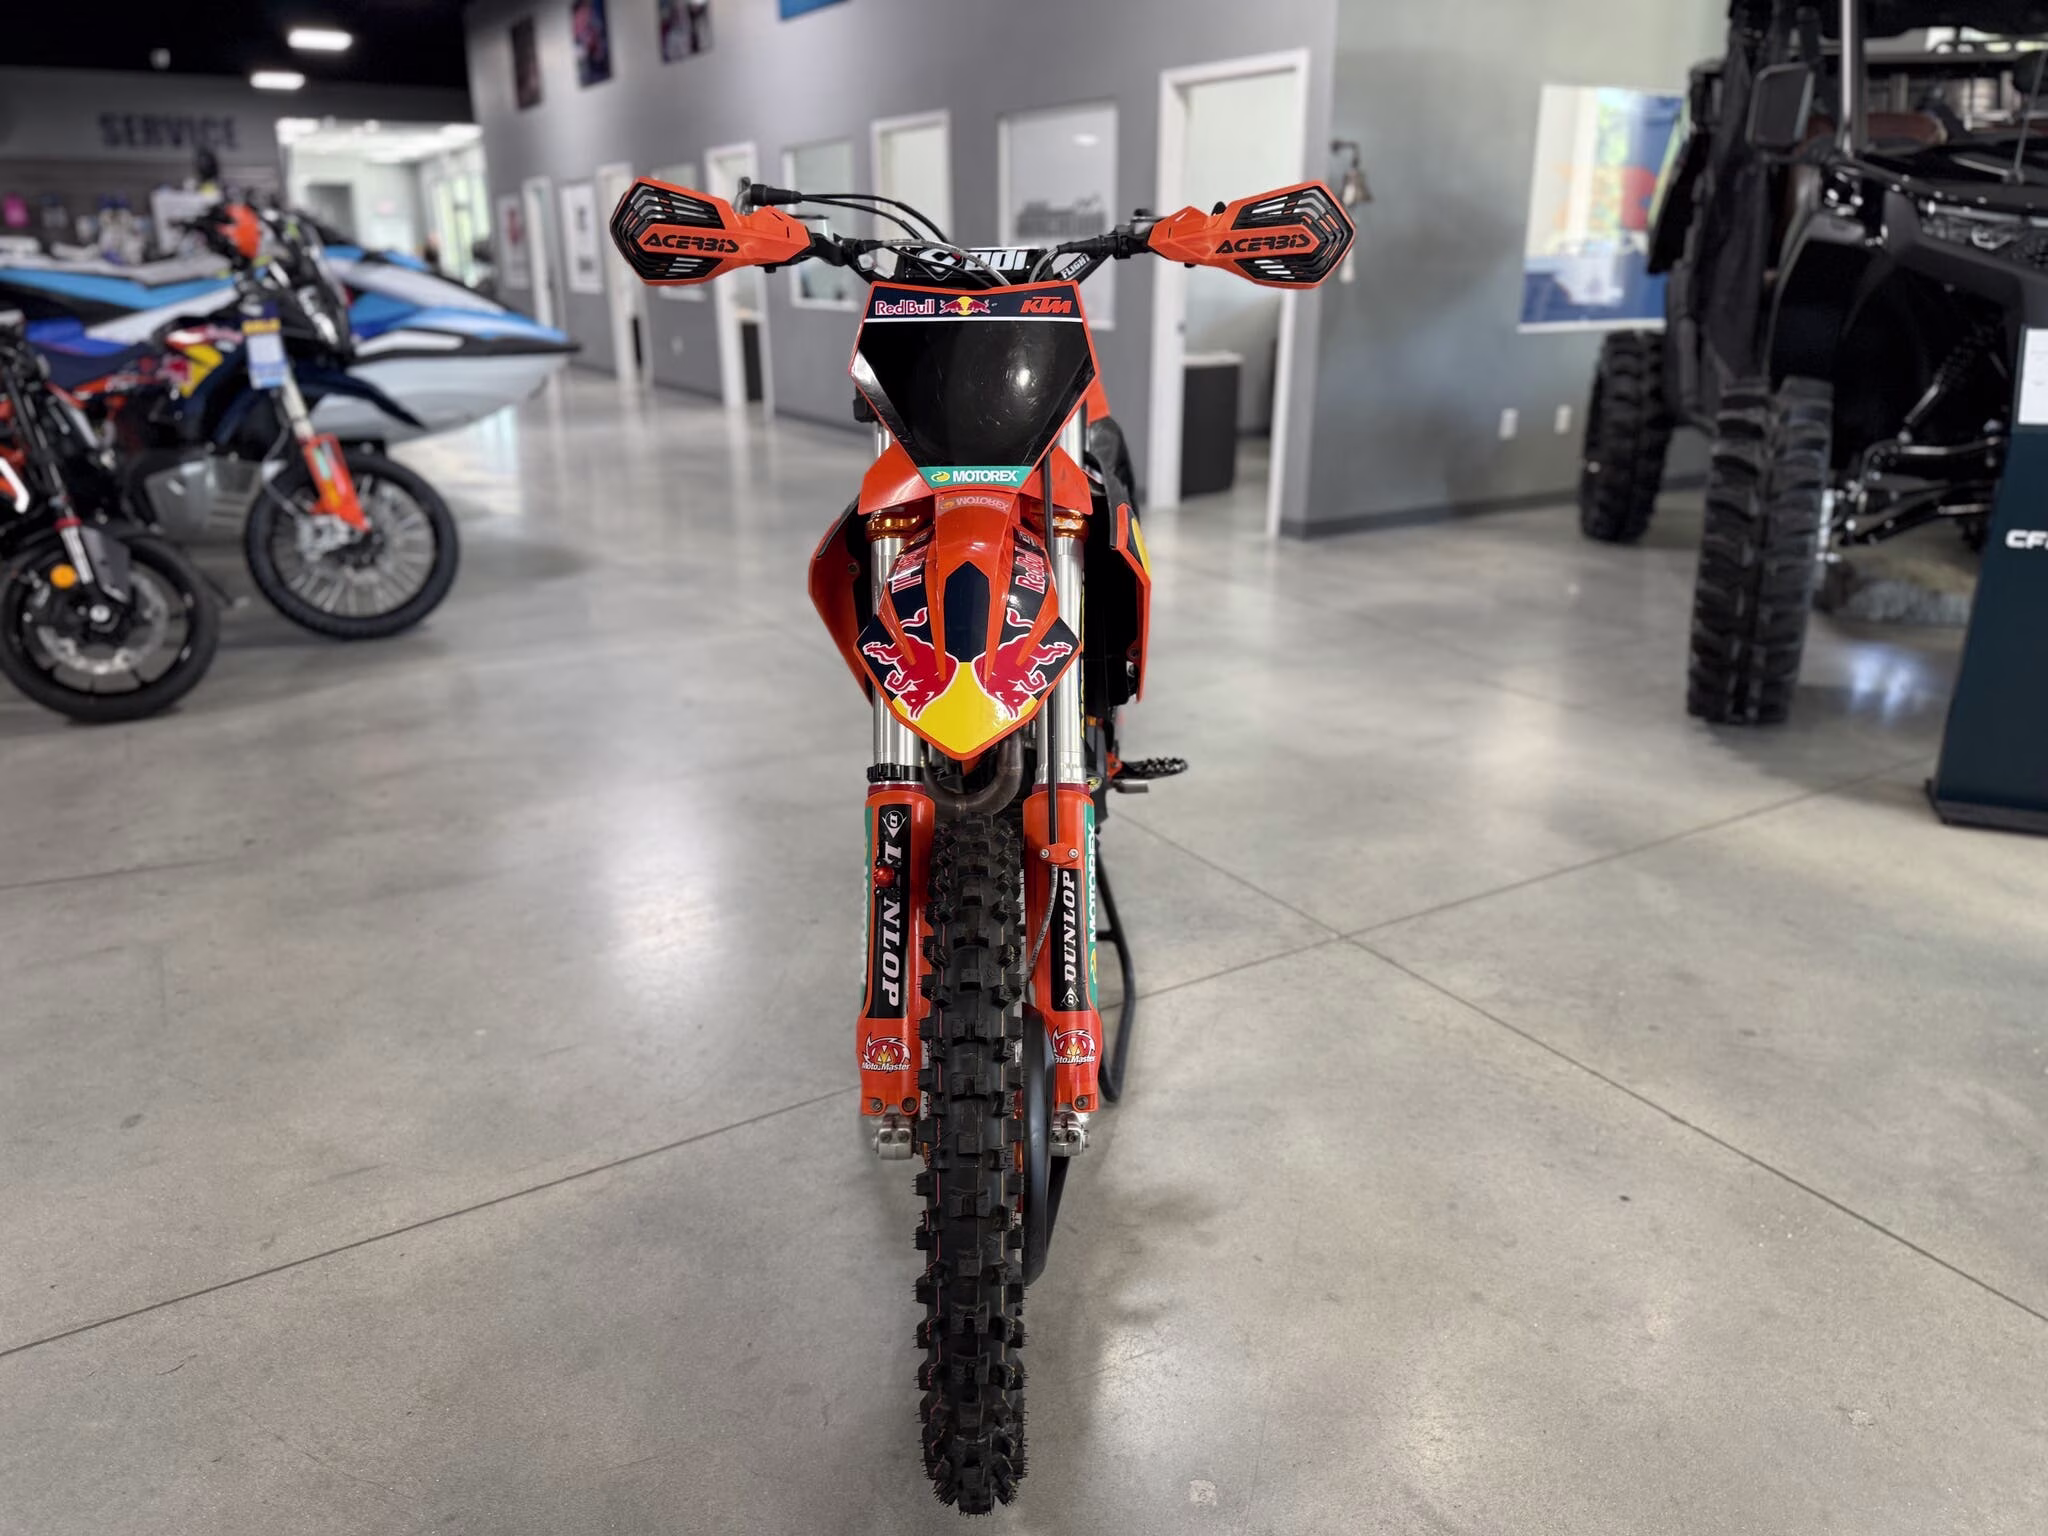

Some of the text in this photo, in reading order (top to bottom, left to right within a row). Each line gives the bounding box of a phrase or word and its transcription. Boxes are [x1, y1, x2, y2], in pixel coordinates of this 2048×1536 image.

[98, 112, 238, 150] SERVICE
[1019, 296, 1072, 314] KTM
[952, 470, 1019, 482] MOTOREX
[2005, 529, 2048, 549] CF
[1063, 870, 1077, 983] DUNLOP
